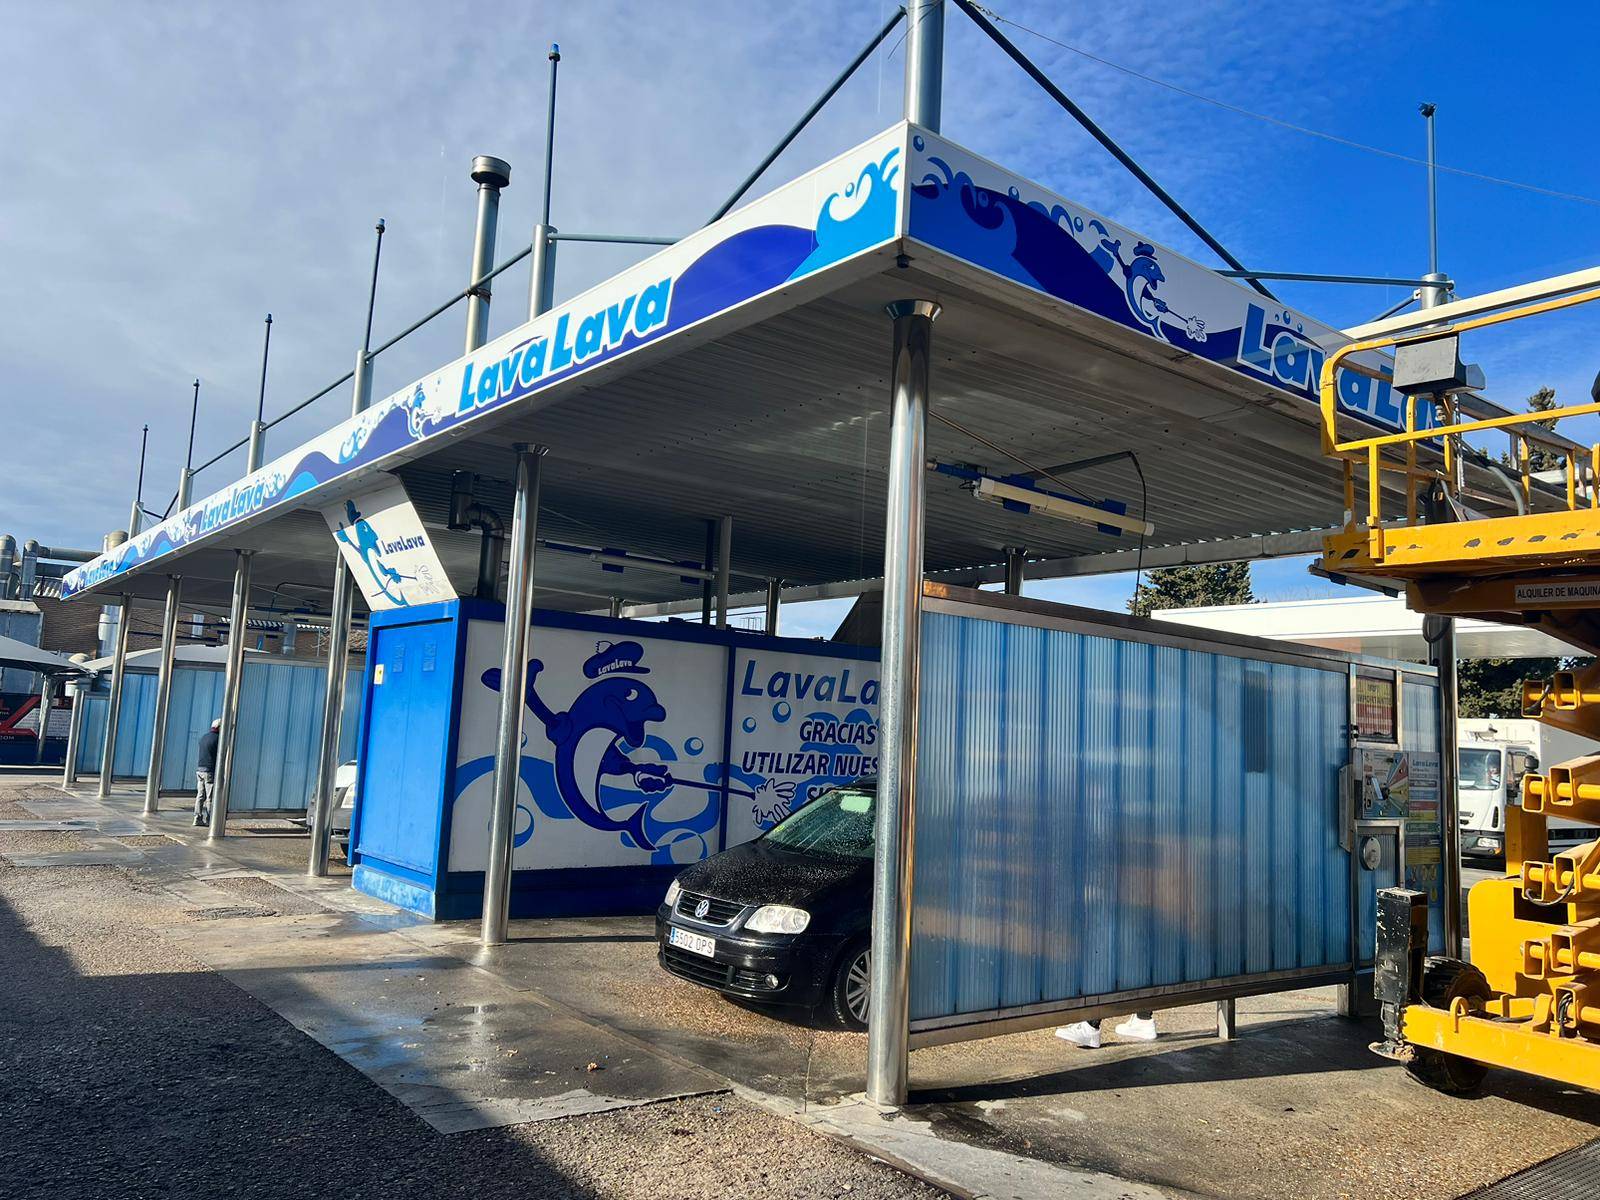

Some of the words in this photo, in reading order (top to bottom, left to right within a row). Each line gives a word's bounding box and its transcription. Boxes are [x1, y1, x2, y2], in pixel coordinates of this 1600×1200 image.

[381, 535, 425, 555] LavaLava
[1517, 587, 1554, 599] ALQUILER
[1555, 587, 1566, 597] DE
[598, 658, 632, 675] LavaLava
[741, 660, 880, 705] LavaLa
[800, 721, 877, 745] GRACIAS
[741, 751, 830, 775] UTILIZAR
[833, 754, 878, 776] NUES
